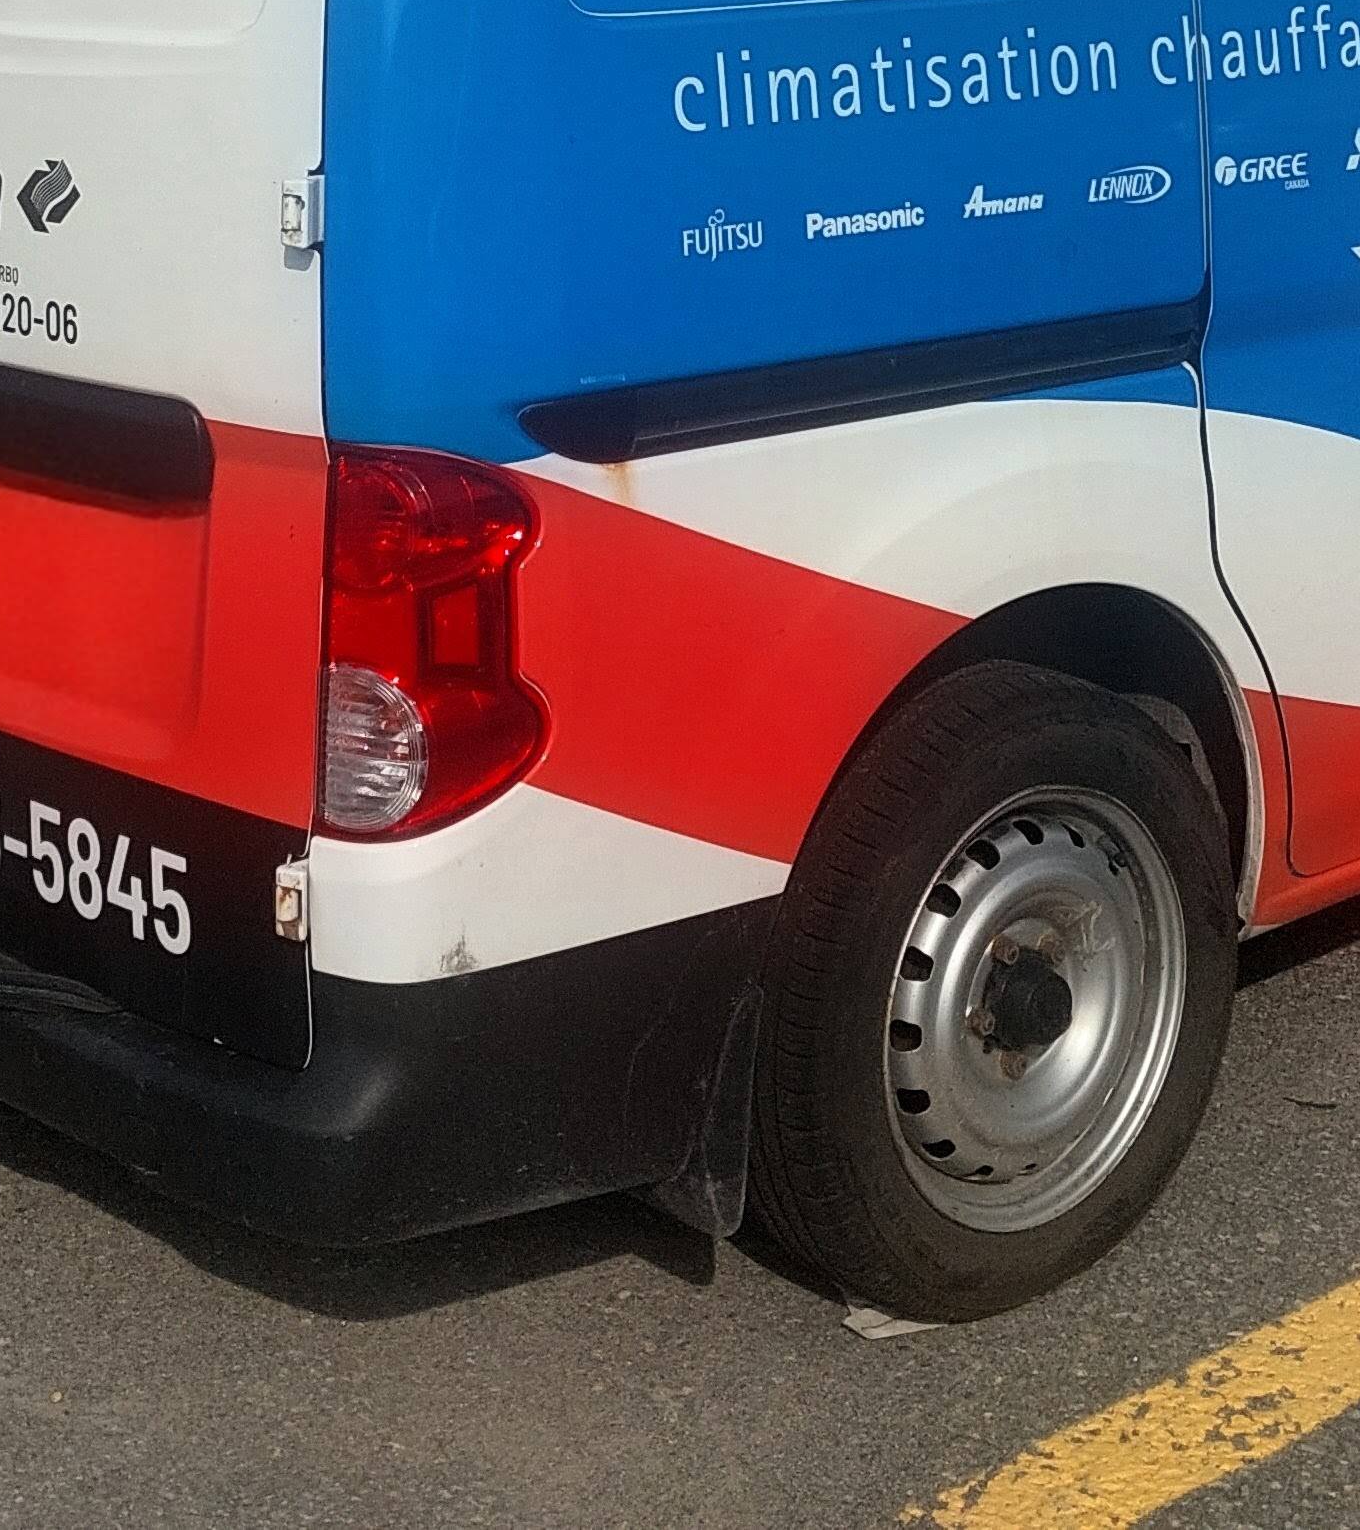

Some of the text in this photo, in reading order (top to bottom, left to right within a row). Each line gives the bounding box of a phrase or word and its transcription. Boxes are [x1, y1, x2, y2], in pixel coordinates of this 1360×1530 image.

[673, 26, 1119, 133] climatisation
[1239, 152, 1308, 183] GREE
[962, 184, 1045, 219] Amana
[1087, 171, 1155, 203] LENNOX
[682, 208, 764, 263] FUJITSU
[805, 201, 926, 239] Panasonic
